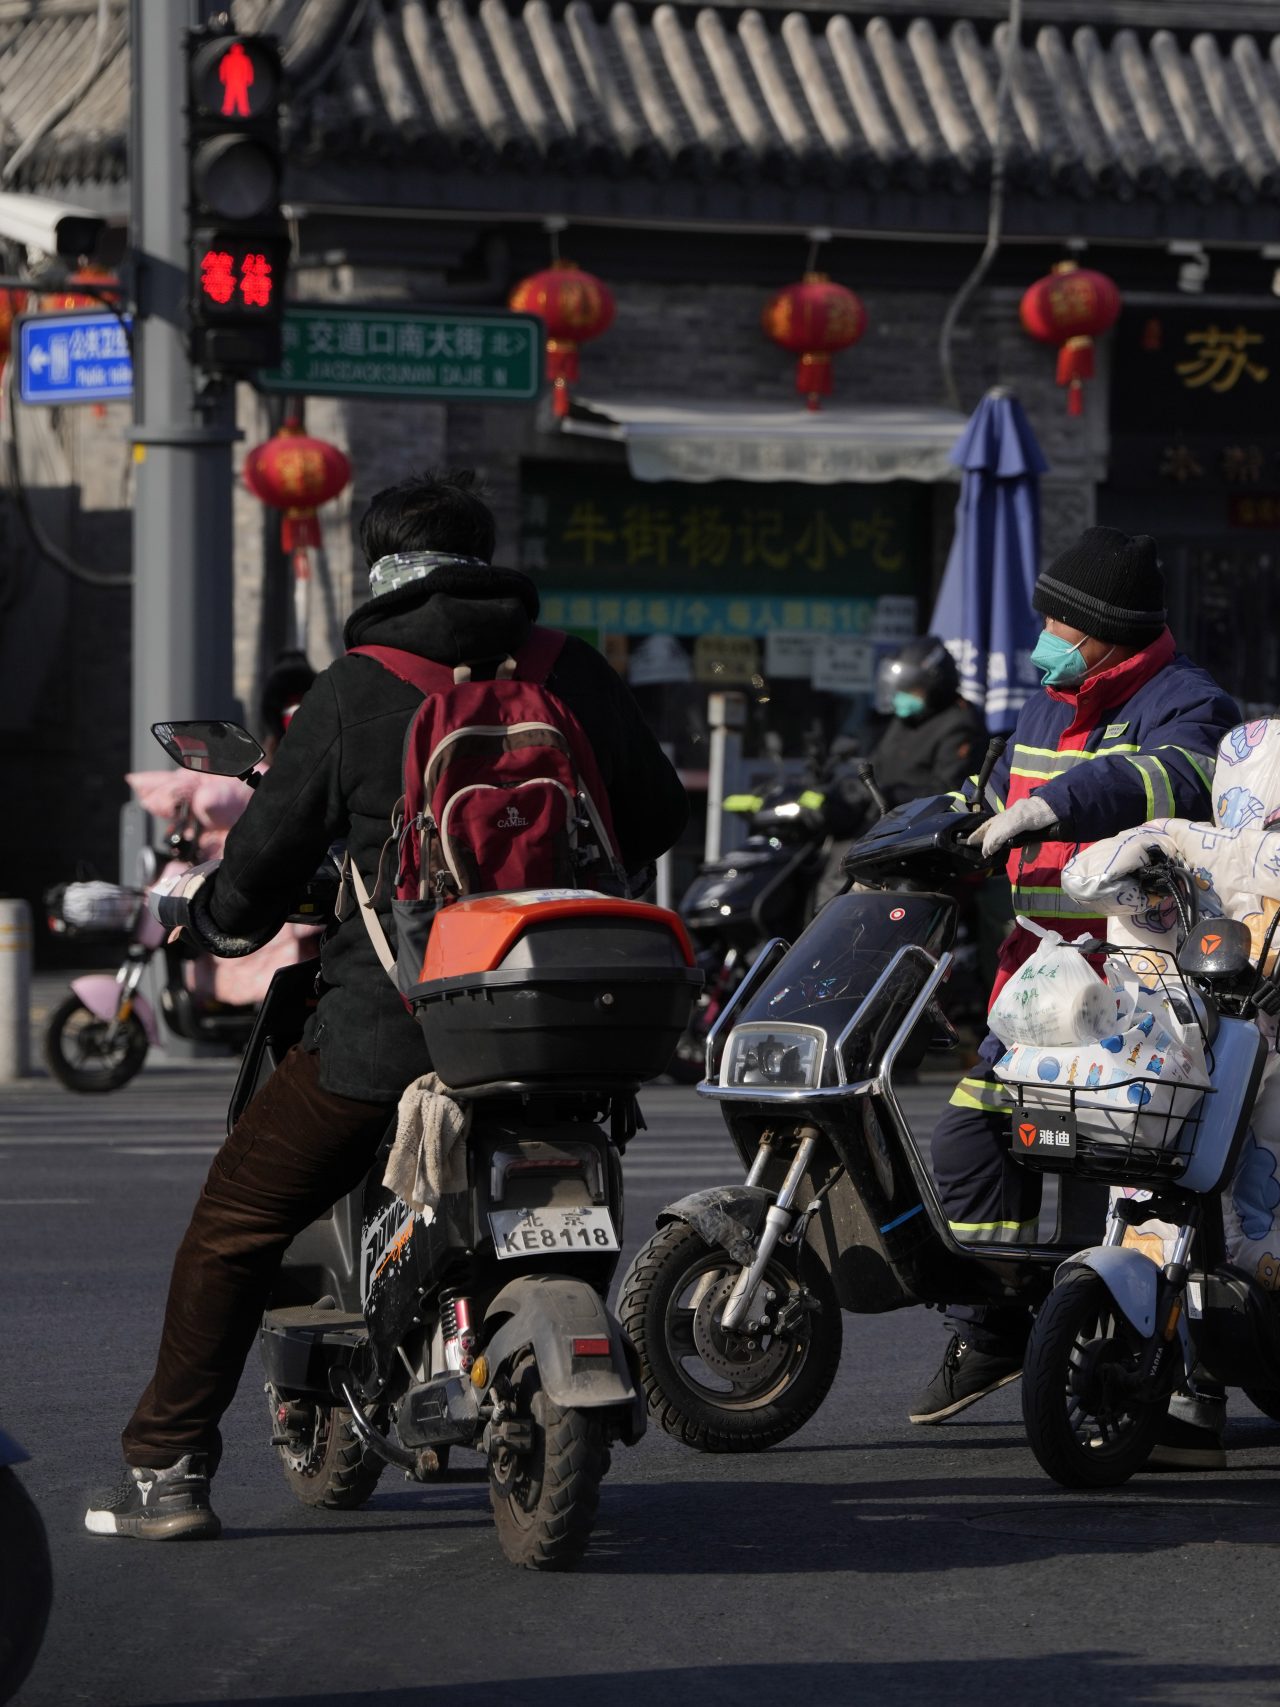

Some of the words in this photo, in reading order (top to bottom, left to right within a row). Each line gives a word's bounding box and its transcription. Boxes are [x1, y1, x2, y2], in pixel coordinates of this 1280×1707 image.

[306, 320, 484, 360] 交道口南大街
[490, 331, 512, 358] 北
[561, 499, 905, 573] 牛街杨记小吃
[496, 817, 529, 828] CAMEL
[1038, 1129, 1071, 1147] 雅迪
[522, 1212, 585, 1228] 北京
[366, 1200, 411, 1300] POWE
[503, 1228, 610, 1253] KE8118
